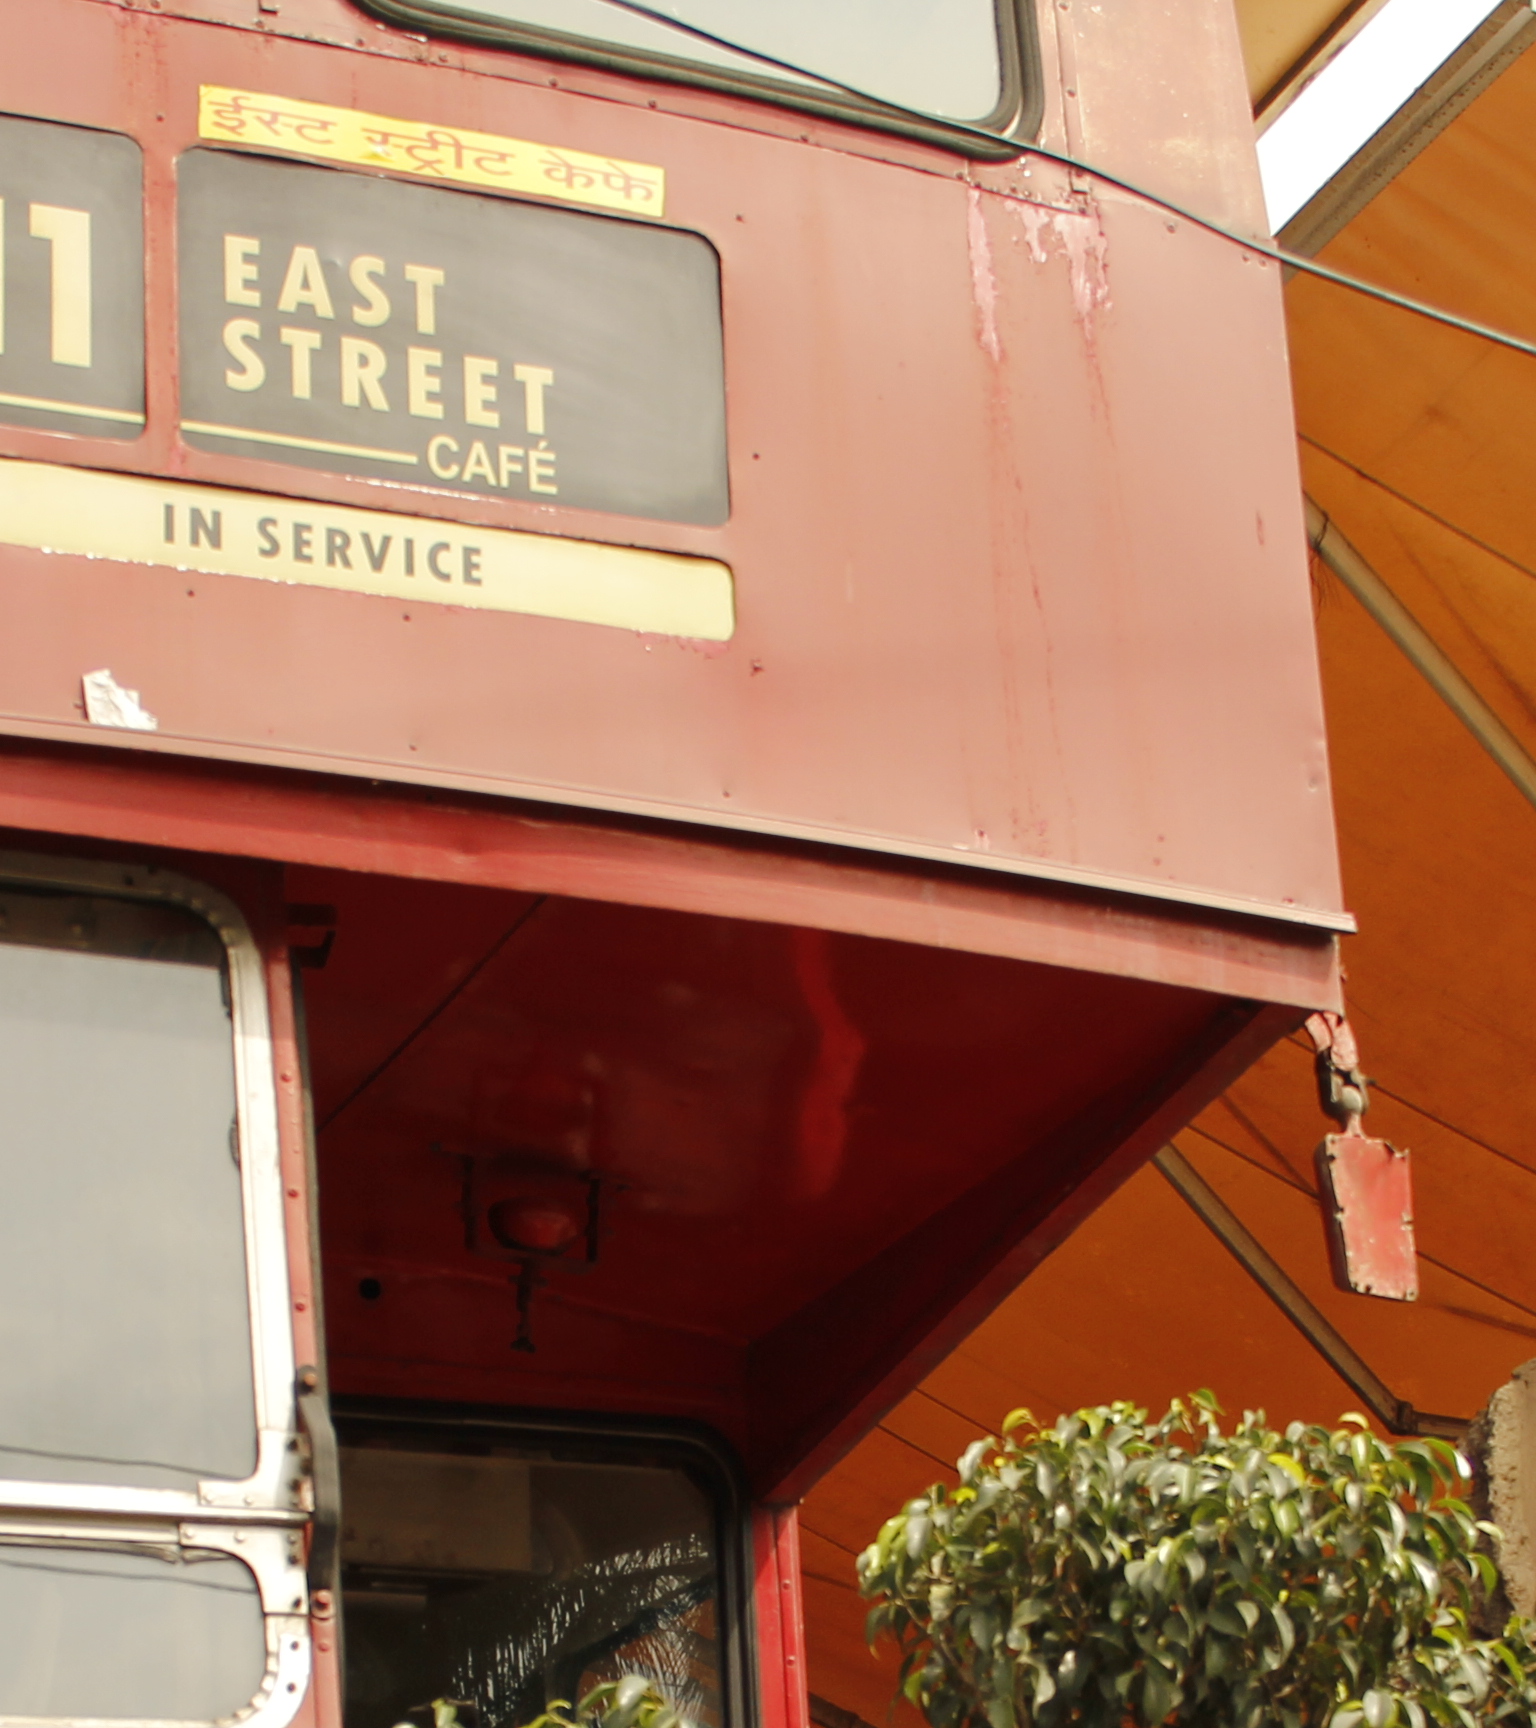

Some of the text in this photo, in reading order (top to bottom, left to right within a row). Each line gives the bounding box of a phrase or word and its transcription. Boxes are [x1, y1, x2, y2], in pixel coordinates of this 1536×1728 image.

[208, 96, 337, 146] ईस्ट
[360, 129, 517, 177] स्ट्रीट
[223, 233, 446, 336] EAST
[222, 318, 555, 436] STREET
[426, 434, 559, 496] CAFÉ
[163, 503, 484, 586] IN SERVICE
